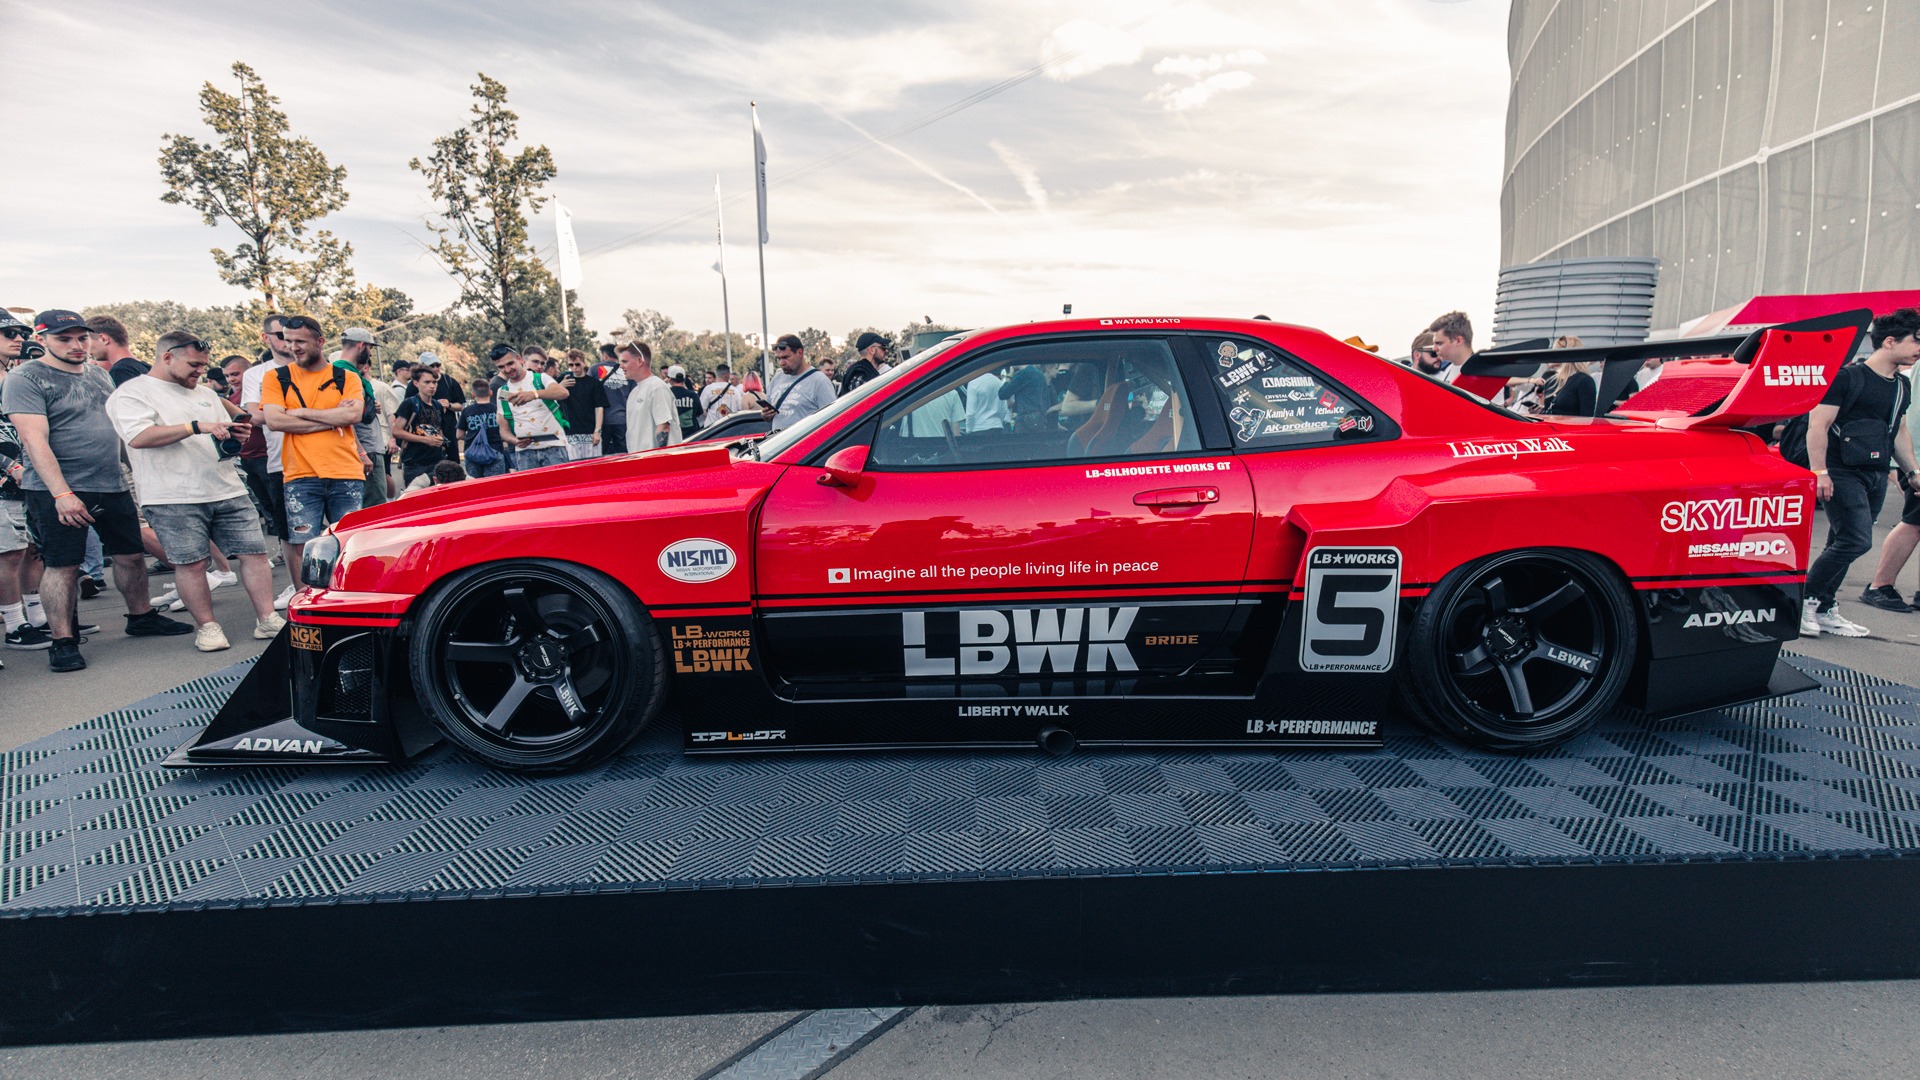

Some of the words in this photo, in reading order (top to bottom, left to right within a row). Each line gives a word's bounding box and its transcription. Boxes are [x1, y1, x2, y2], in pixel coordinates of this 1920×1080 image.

[1219, 360, 1259, 387] LBWK
[1763, 365, 1827, 386] LBWK
[1446, 441, 1518, 460] Liberty
[1516, 437, 1575, 453] Walk
[1085, 465, 1171, 478] LB-SILHOUETTE
[1172, 462, 1214, 473] WORKS
[1216, 462, 1230, 470] GT
[1660, 495, 1803, 532] SKYLINE
[667, 549, 728, 567] NISMO
[1688, 542, 1739, 554] NISSAN
[854, 567, 915, 582] Imagine
[920, 565, 937, 578] all
[941, 565, 965, 578] the
[970, 562, 1021, 579] people
[1026, 562, 1064, 577] living
[1069, 561, 1091, 574] life
[1096, 560, 1108, 572] in
[1113, 561, 1158, 575] peace
[1310, 574, 1393, 656] 5
[1683, 608, 1776, 628] ADVAN
[290, 626, 320, 644] NGK
[902, 606, 1140, 676] LBWK
[1144, 634, 1198, 646] BRIDE
[674, 648, 752, 673] LBWK
[1548, 647, 1592, 670] LBWK
[558, 683, 579, 716] LBWK
[958, 706, 1022, 716] LIBERTY
[1024, 705, 1070, 716] WALK
[232, 738, 323, 754] ADVAN
